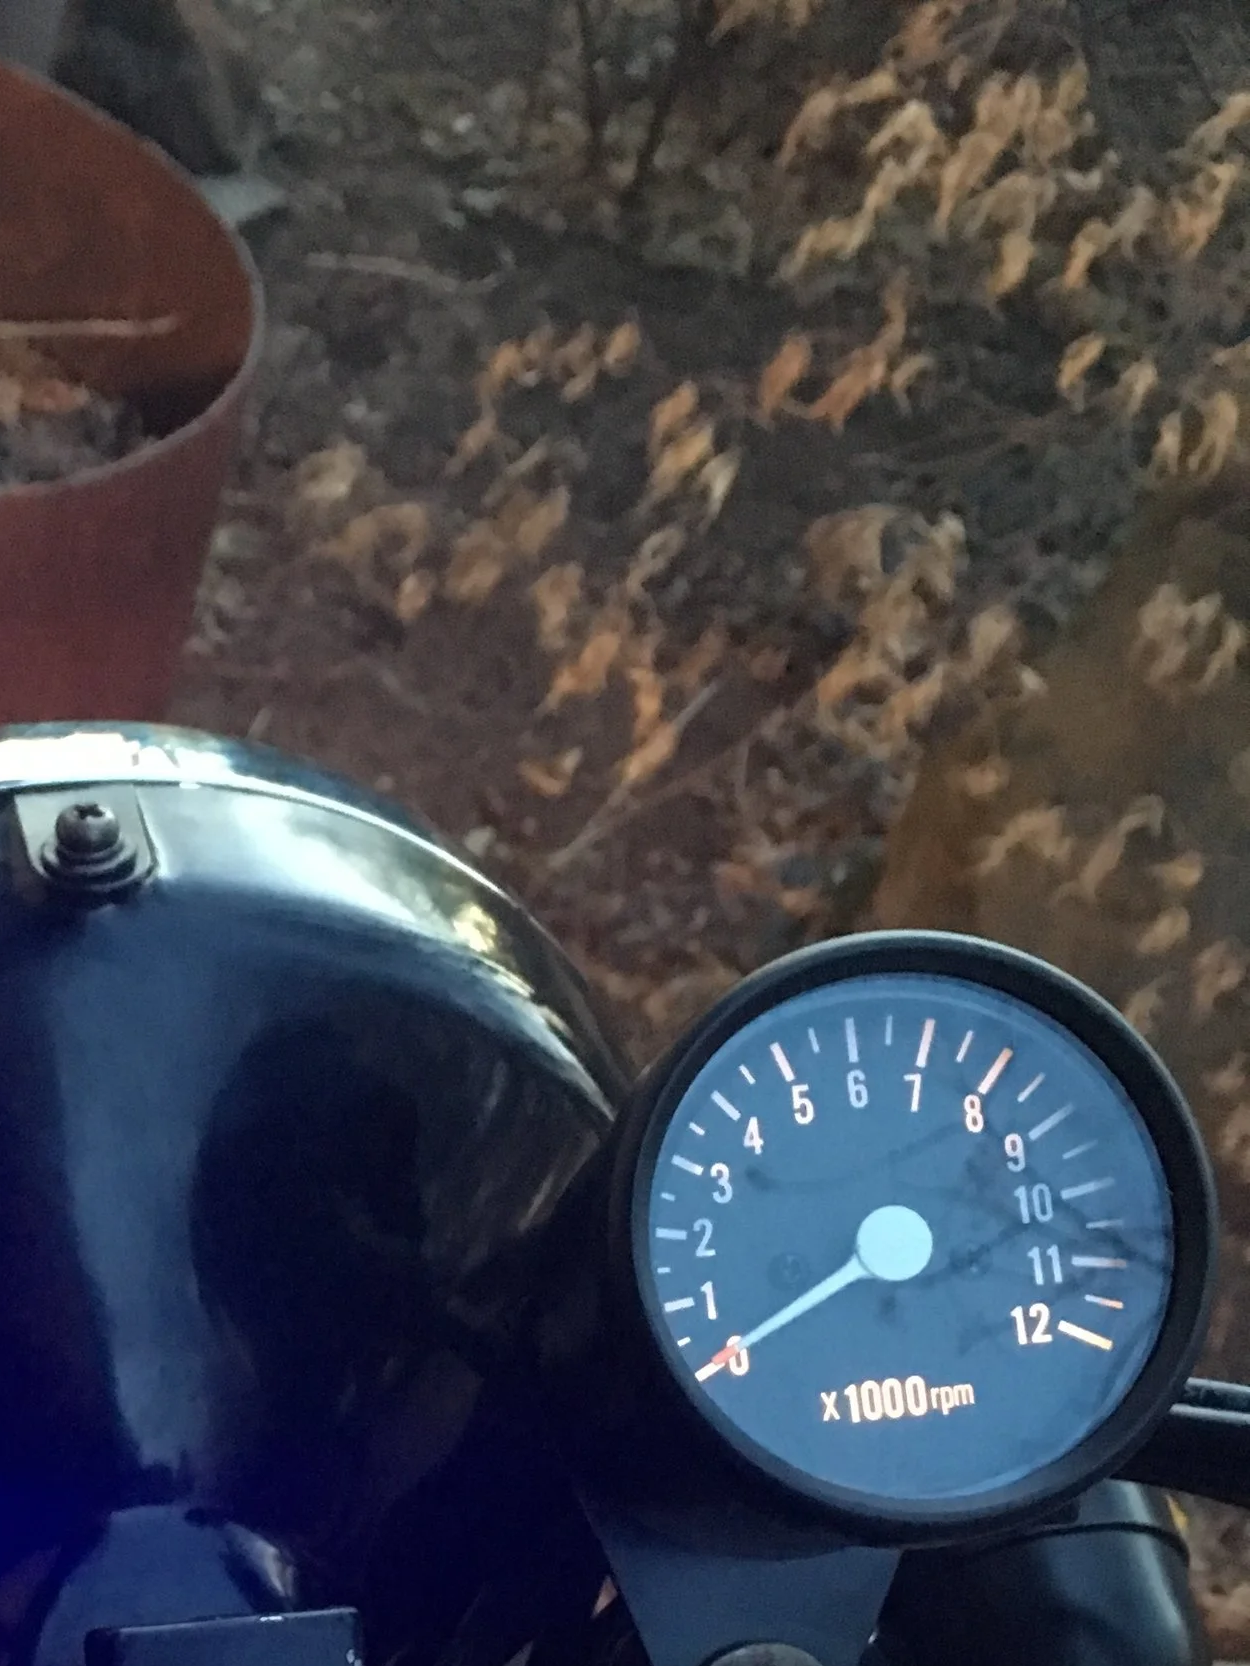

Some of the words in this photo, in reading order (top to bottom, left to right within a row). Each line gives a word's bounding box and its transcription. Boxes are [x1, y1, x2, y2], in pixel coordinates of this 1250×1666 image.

[791, 1084, 815, 1124] 5
[846, 1070, 868, 1108] 6
[903, 1073, 922, 1113] 7
[963, 1094, 984, 1133] 8
[743, 1116, 764, 1155] 4
[1004, 1133, 1026, 1172] 9
[709, 1163, 734, 1204] 3
[1013, 1183, 1053, 1224] 10
[692, 1218, 716, 1258] 2
[1027, 1244, 1063, 1286] 11
[700, 1280, 717, 1320] 1
[1010, 1302, 1053, 1345] 12
